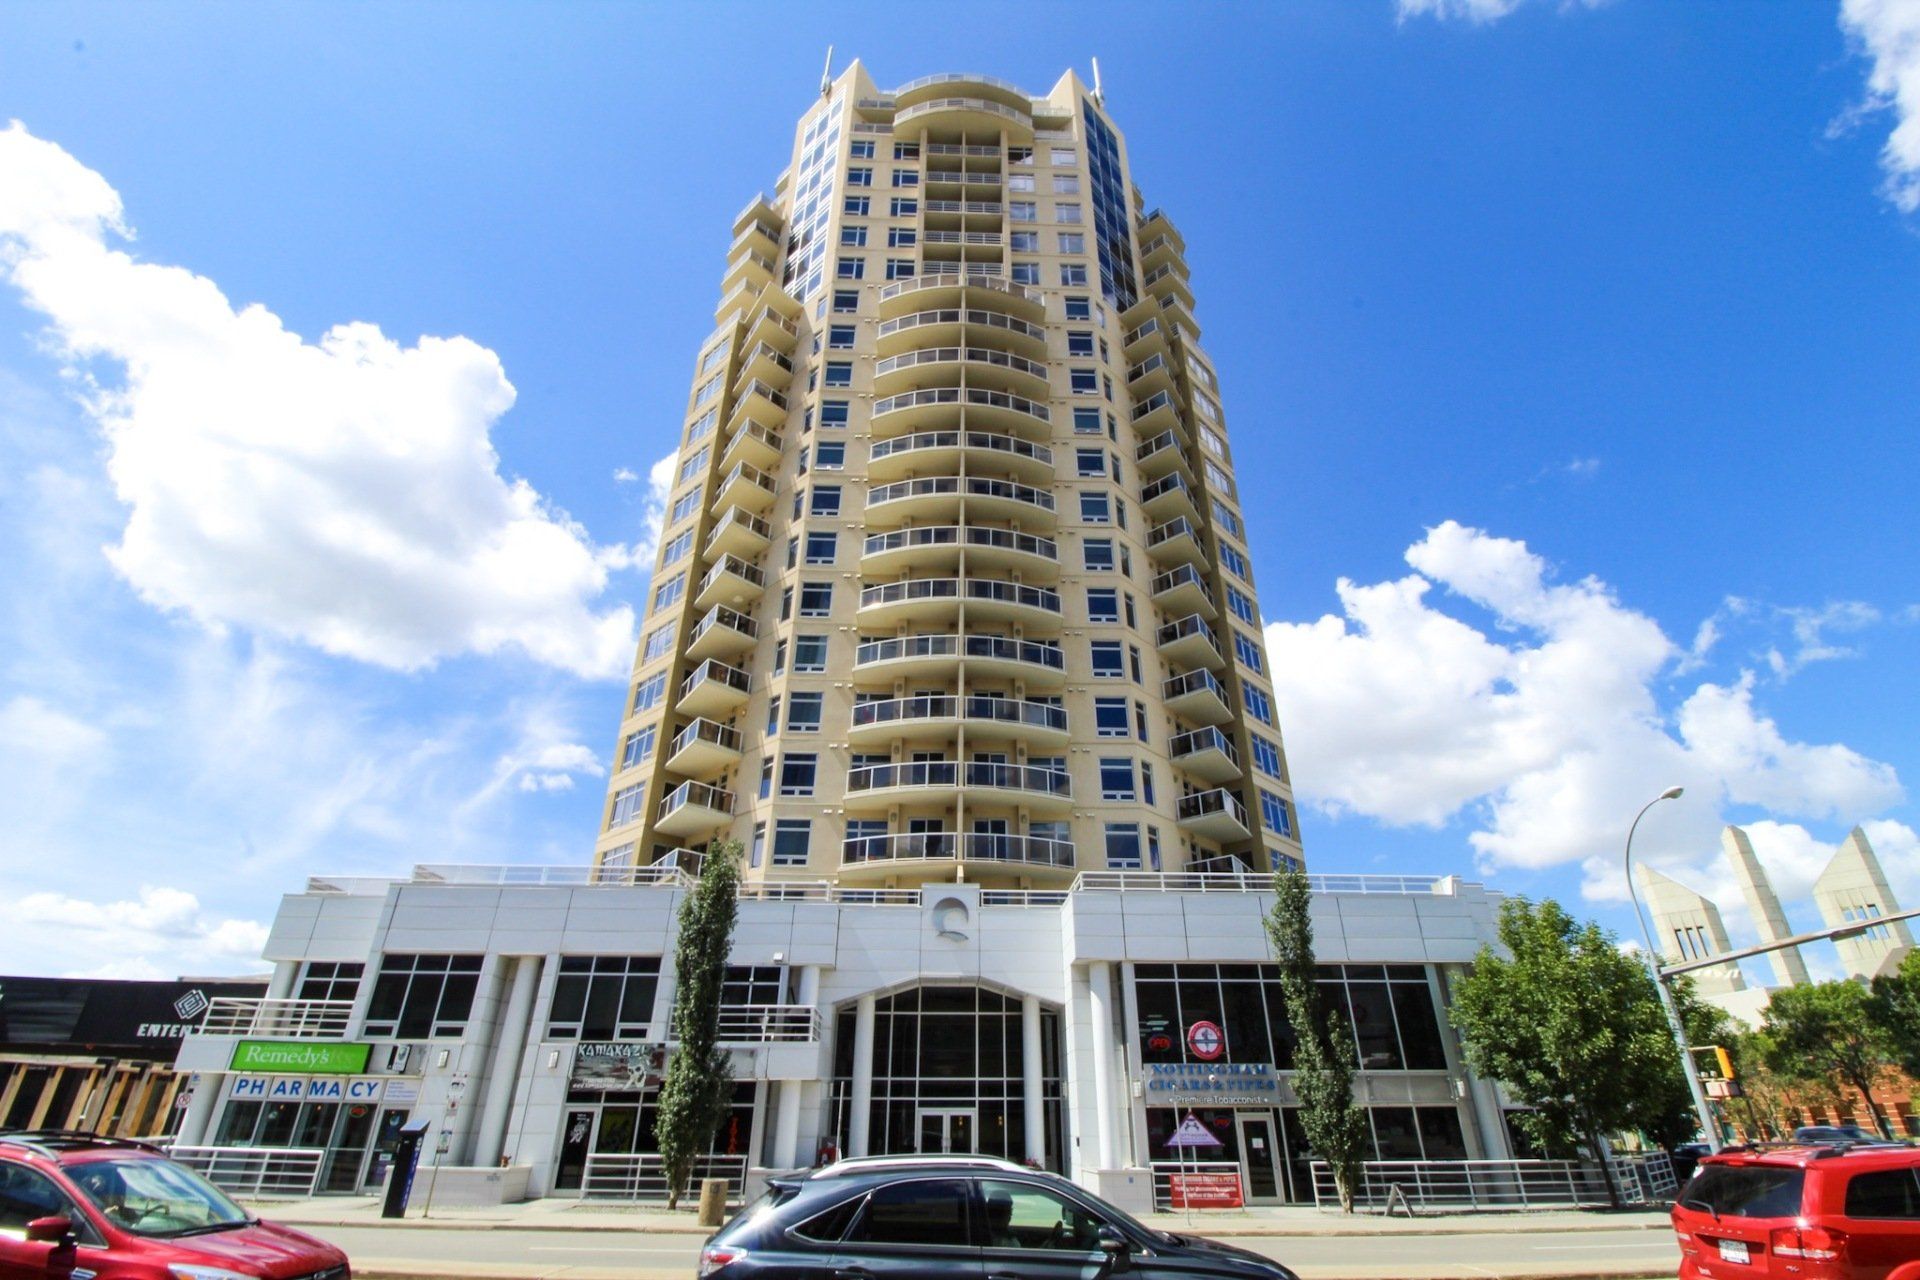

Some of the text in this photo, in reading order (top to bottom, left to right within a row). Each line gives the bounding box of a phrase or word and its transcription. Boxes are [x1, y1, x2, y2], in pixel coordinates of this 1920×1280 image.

[244, 1044, 330, 1068] Remedy's
[1151, 1064, 1268, 1077] NOTTINGHAM
[235, 1079, 378, 1098] PHARMACY
